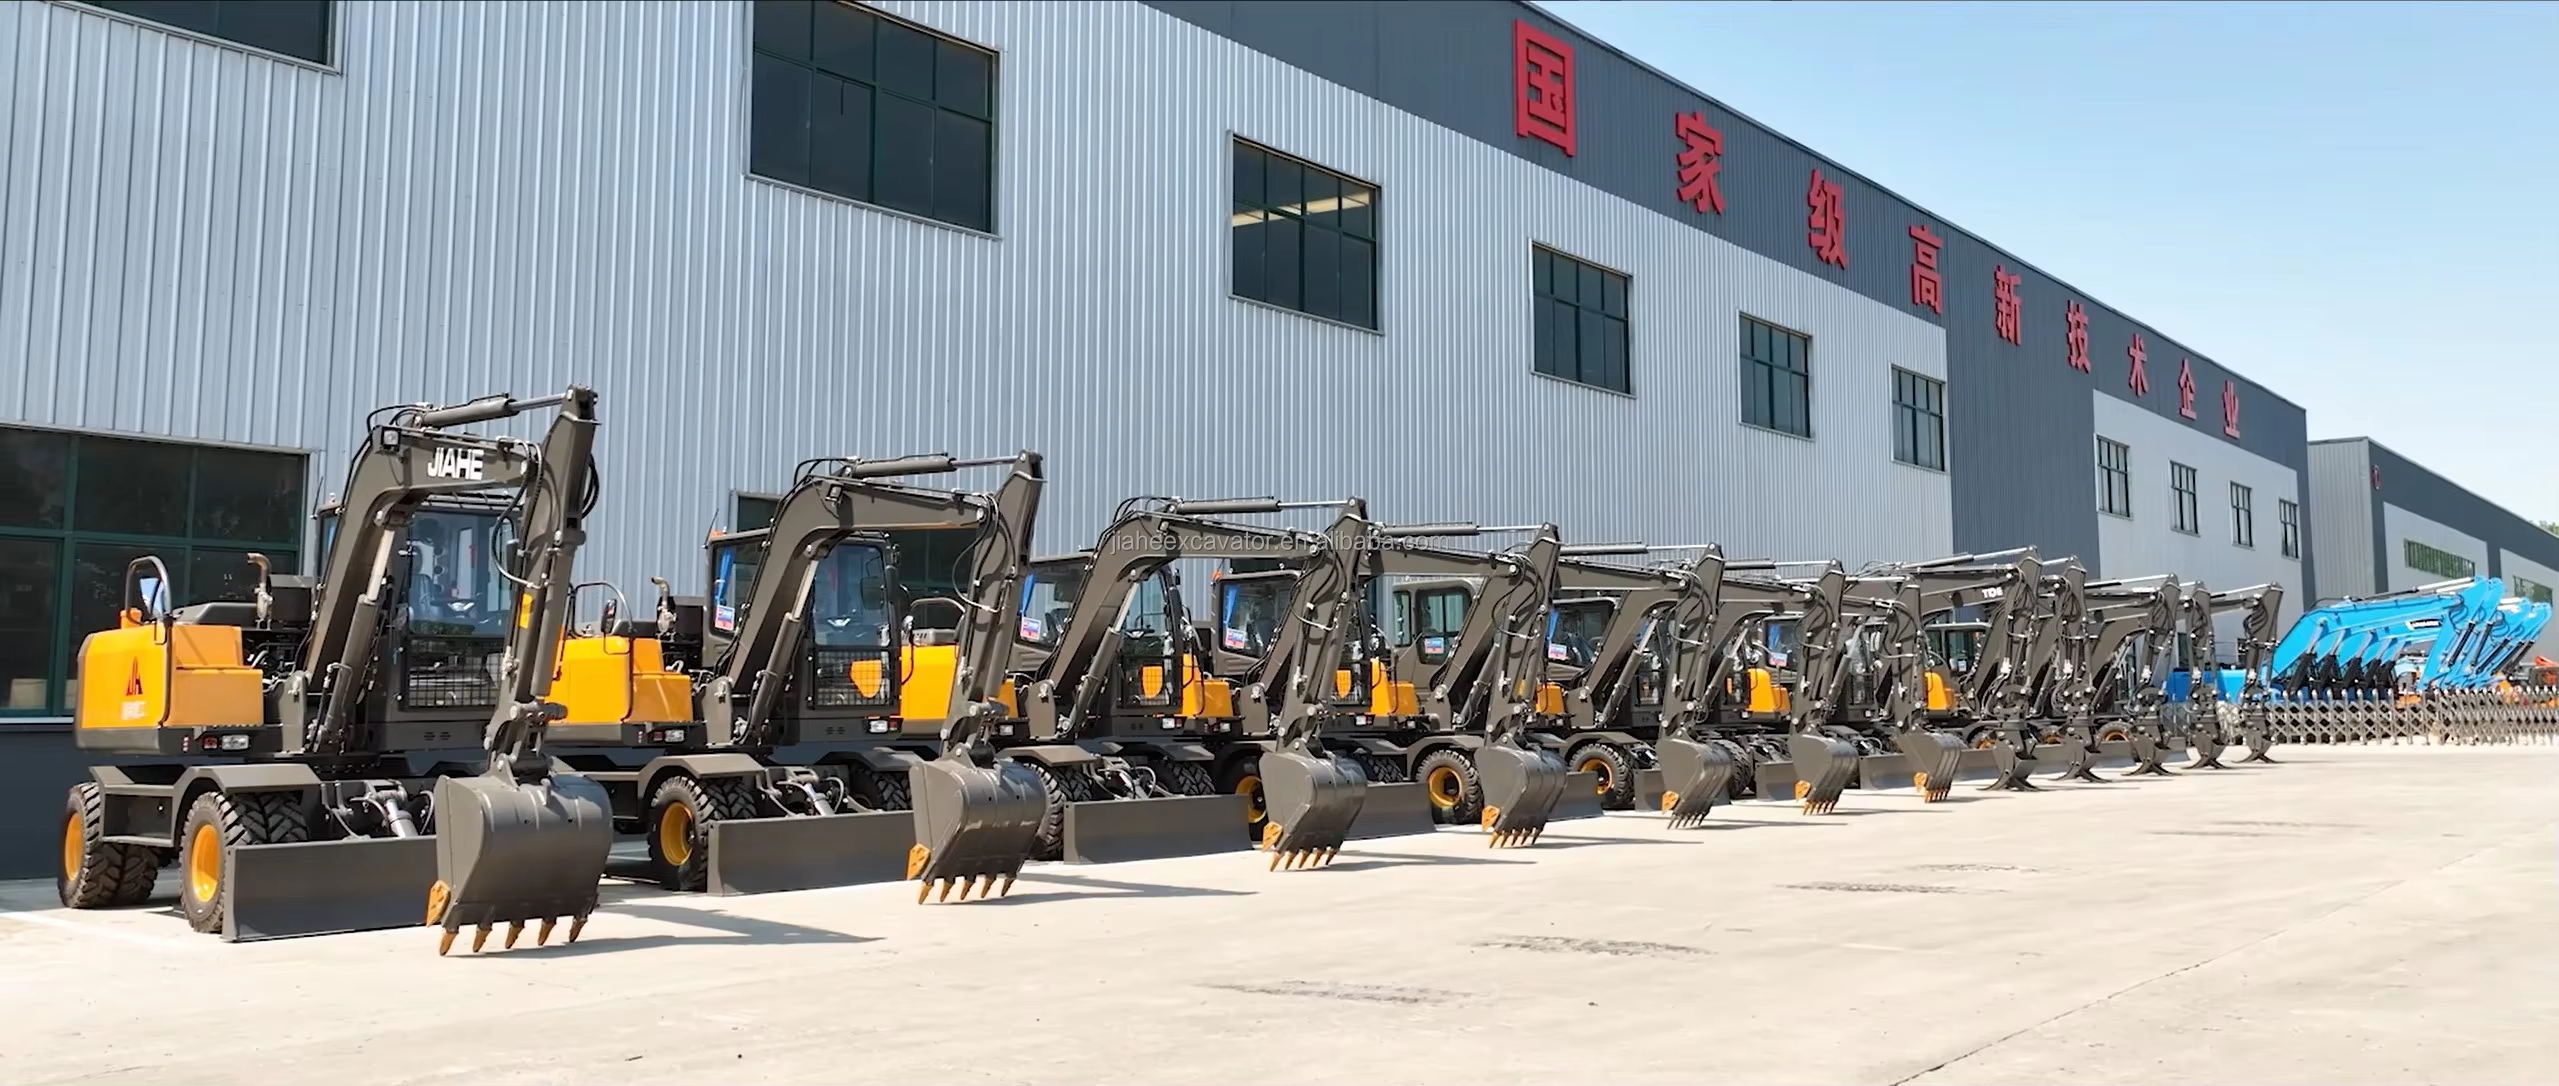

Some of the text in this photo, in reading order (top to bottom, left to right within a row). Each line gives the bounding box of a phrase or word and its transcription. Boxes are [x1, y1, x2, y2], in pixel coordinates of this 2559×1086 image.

[1513, 18, 2241, 440] 国家级高新技术企业
[427, 446, 485, 481] JIAHE
